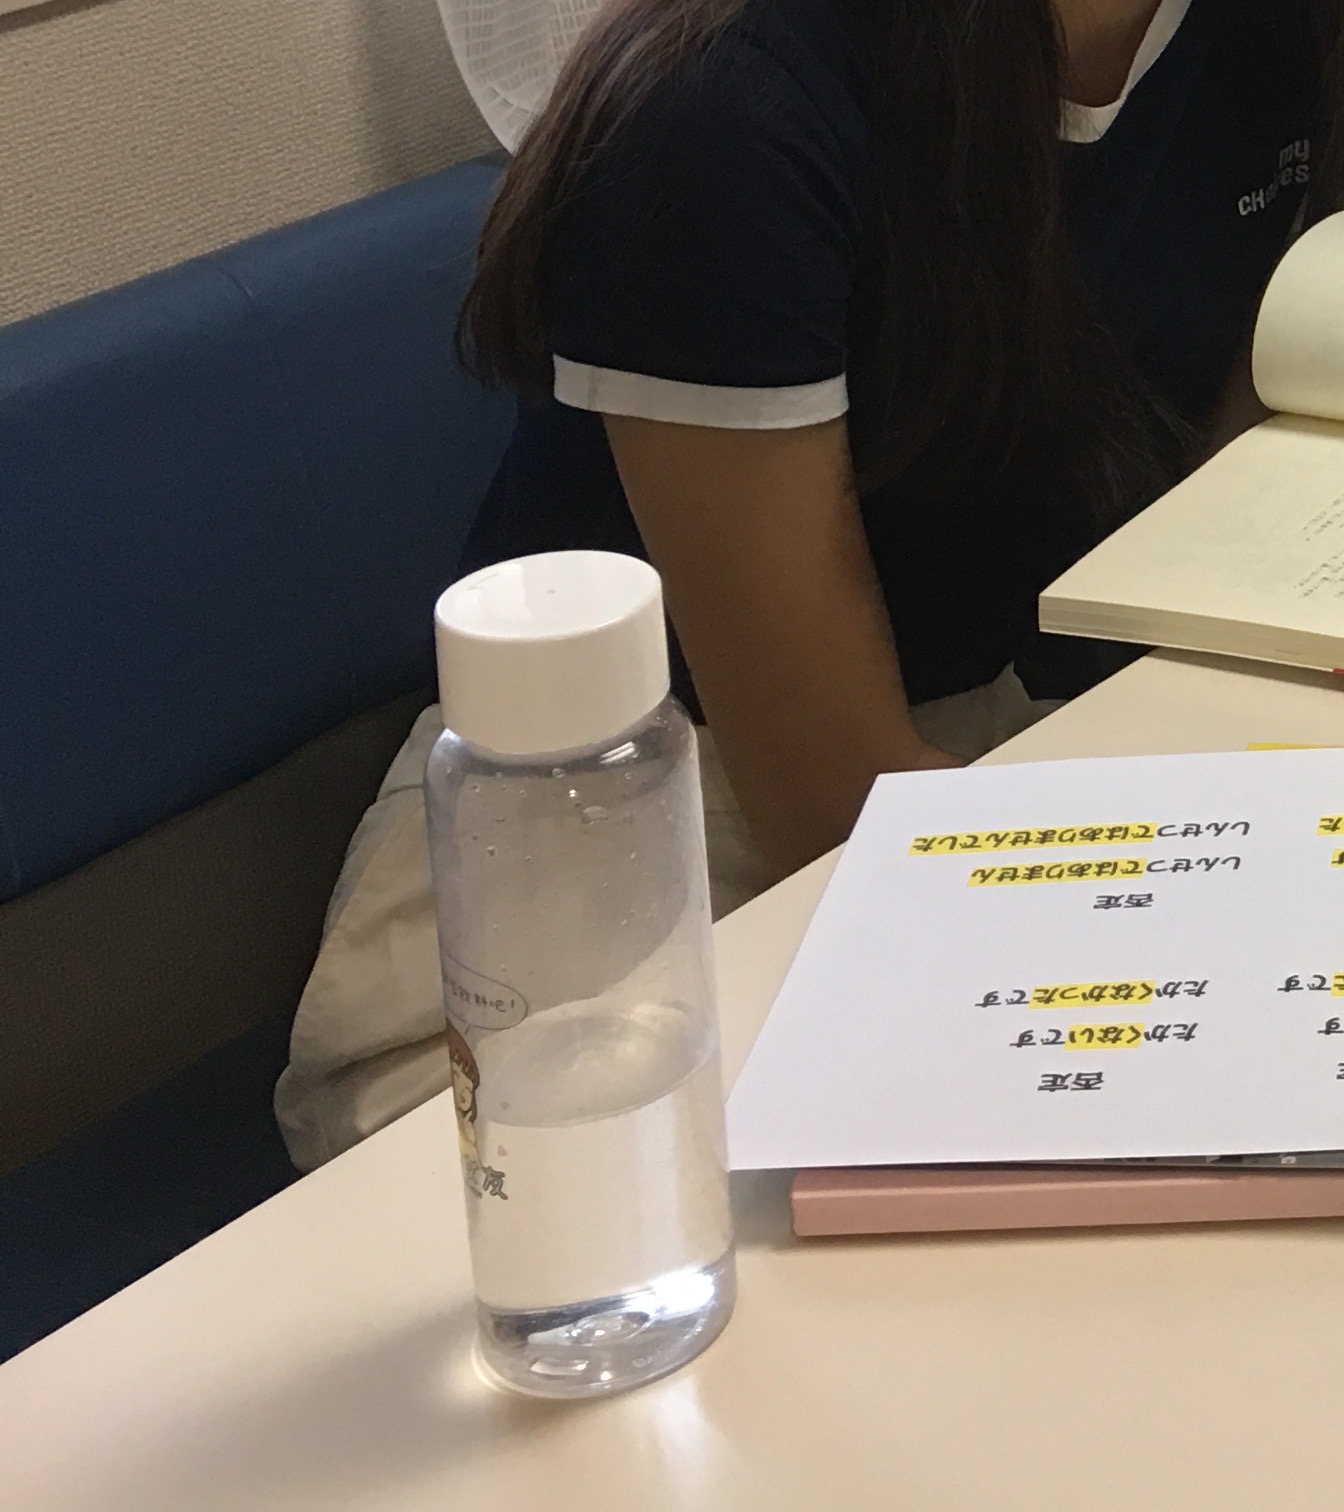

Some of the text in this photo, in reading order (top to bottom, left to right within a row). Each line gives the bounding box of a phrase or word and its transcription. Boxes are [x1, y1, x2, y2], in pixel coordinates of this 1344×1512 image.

[912, 821, 1251, 852] しんせつではありませんでした
[971, 856, 1241, 884] しんせつではありません
[1092, 892, 1154, 910] 否定
[974, 979, 1209, 1009] たかくなかったです
[1009, 1022, 1199, 1049] たかくないです
[1036, 1071, 1105, 1093] 否定
